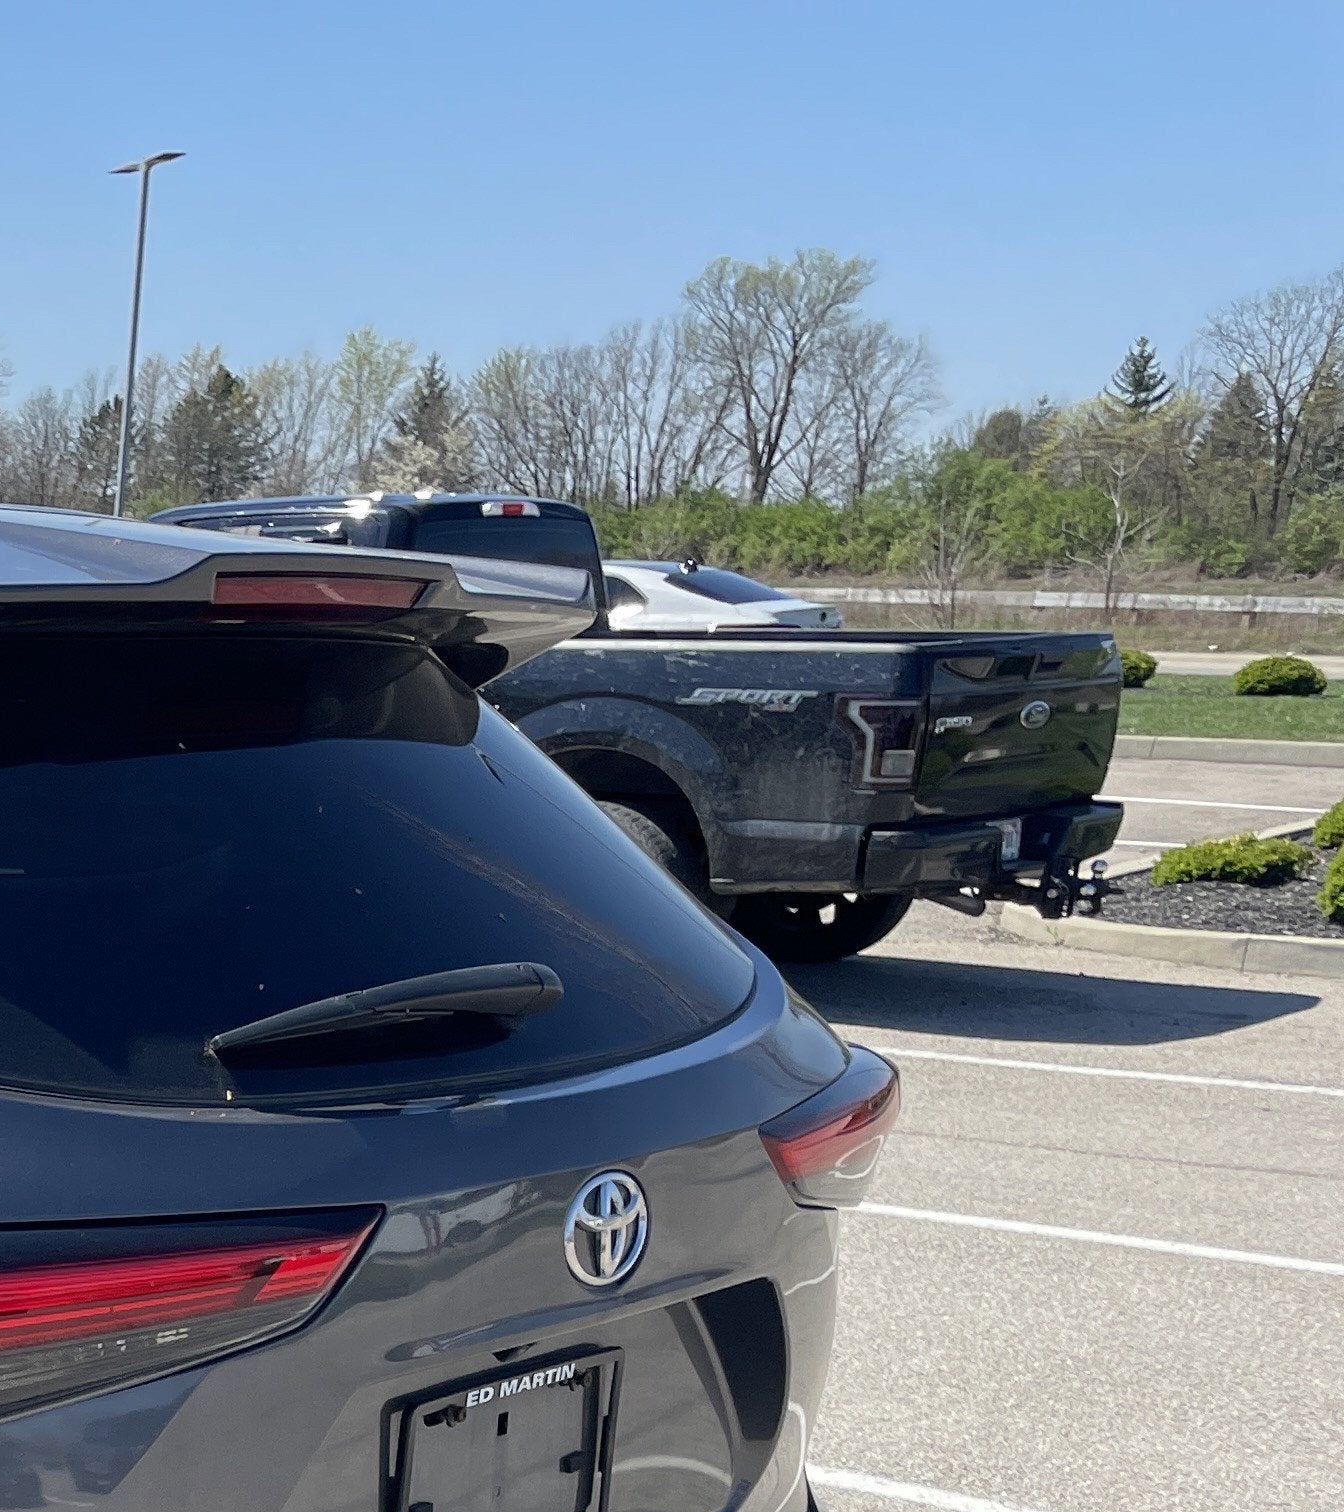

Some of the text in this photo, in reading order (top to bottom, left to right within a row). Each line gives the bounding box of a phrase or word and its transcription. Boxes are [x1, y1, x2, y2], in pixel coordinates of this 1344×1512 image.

[675, 687, 818, 708] SPORT
[465, 1363, 576, 1408] ED MARTIN
